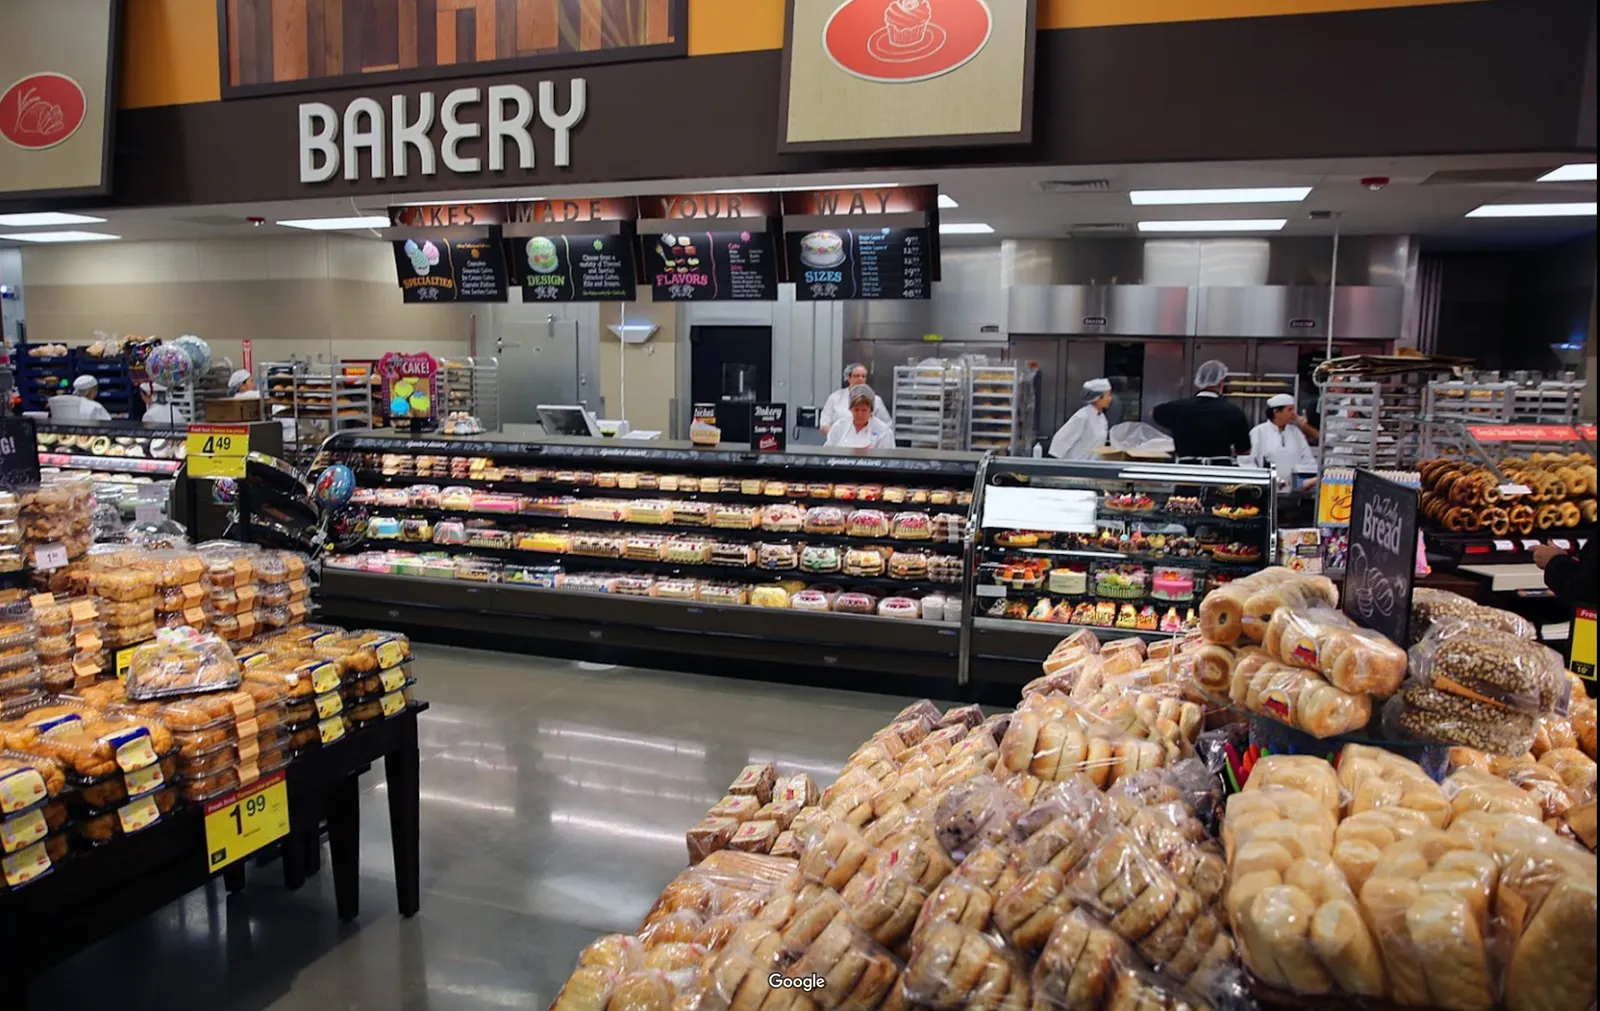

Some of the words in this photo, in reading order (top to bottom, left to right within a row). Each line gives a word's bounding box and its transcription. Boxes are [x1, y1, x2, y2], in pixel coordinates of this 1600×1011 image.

[299, 78, 587, 183] BAKERY
[394, 205, 476, 227] CAKES
[515, 199, 602, 223] MADE
[659, 194, 743, 220] YOUR
[815, 191, 893, 216] WAY
[403, 276, 453, 289] SPECIALTIES
[527, 275, 566, 287] DESIGN
[656, 273, 709, 287] FLAVORS
[805, 270, 842, 283] SIZES
[402, 361, 430, 374] CAKE!
[754, 406, 783, 420] Bakery
[1362, 502, 1403, 555] Bread
